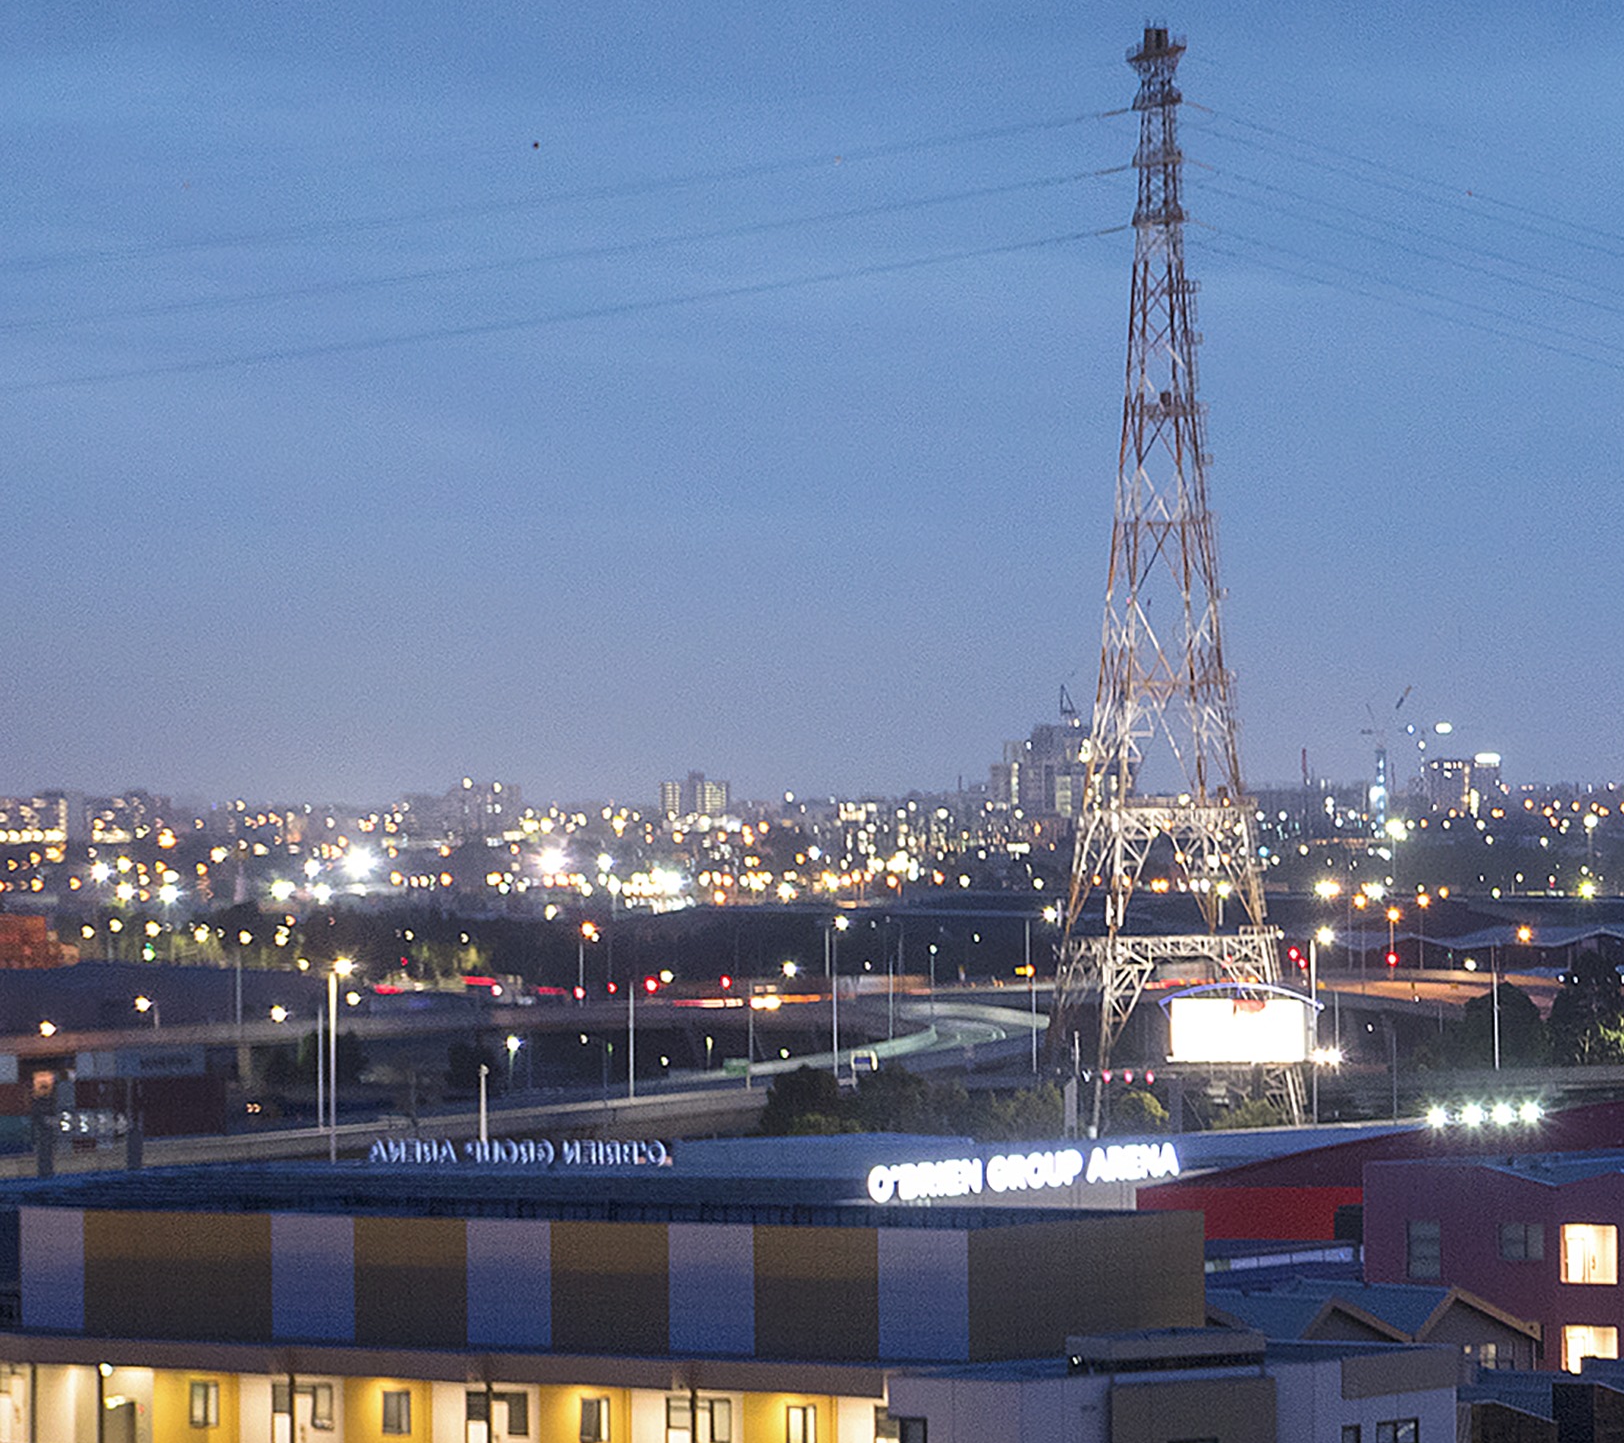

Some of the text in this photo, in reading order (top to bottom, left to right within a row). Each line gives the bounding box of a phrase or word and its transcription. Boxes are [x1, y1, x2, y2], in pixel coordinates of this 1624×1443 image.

[867, 1141, 1180, 1204] O'BRIEN GROUP ARENA
